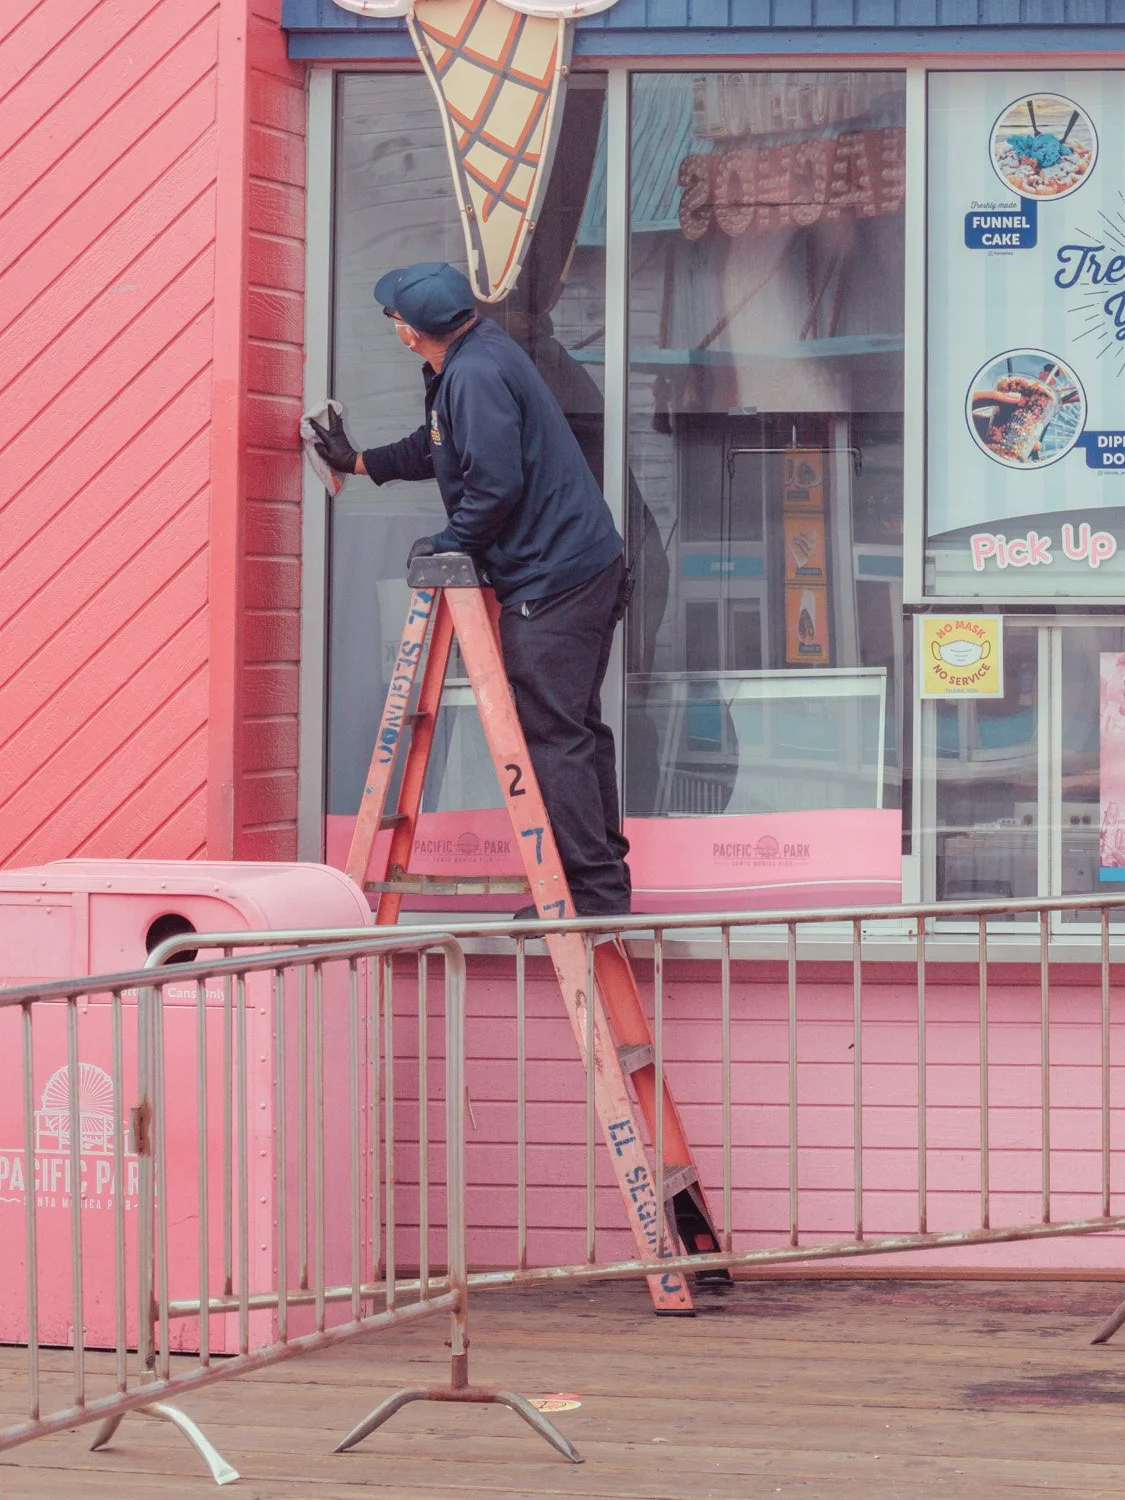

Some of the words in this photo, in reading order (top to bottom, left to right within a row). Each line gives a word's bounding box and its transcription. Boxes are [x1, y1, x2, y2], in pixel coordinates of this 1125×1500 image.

[972, 216, 1031, 229] FUNNEL
[981, 233, 1021, 246] CAKE
[970, 530, 1053, 572] Pick
[1061, 522, 1117, 569] Up
[935, 623, 953, 639] NO
[955, 620, 986, 639] MASK
[932, 664, 948, 680] NO
[948, 663, 991, 686] SERVICE
[504, 763, 526, 798] 2
[414, 840, 453, 854] PACIFIC
[484, 840, 511, 854] PARK
[520, 827, 544, 865] 7
[713, 843, 752, 857] PACIFIC
[783, 843, 810, 857] PARK
[608, 1120, 637, 1157] EL
